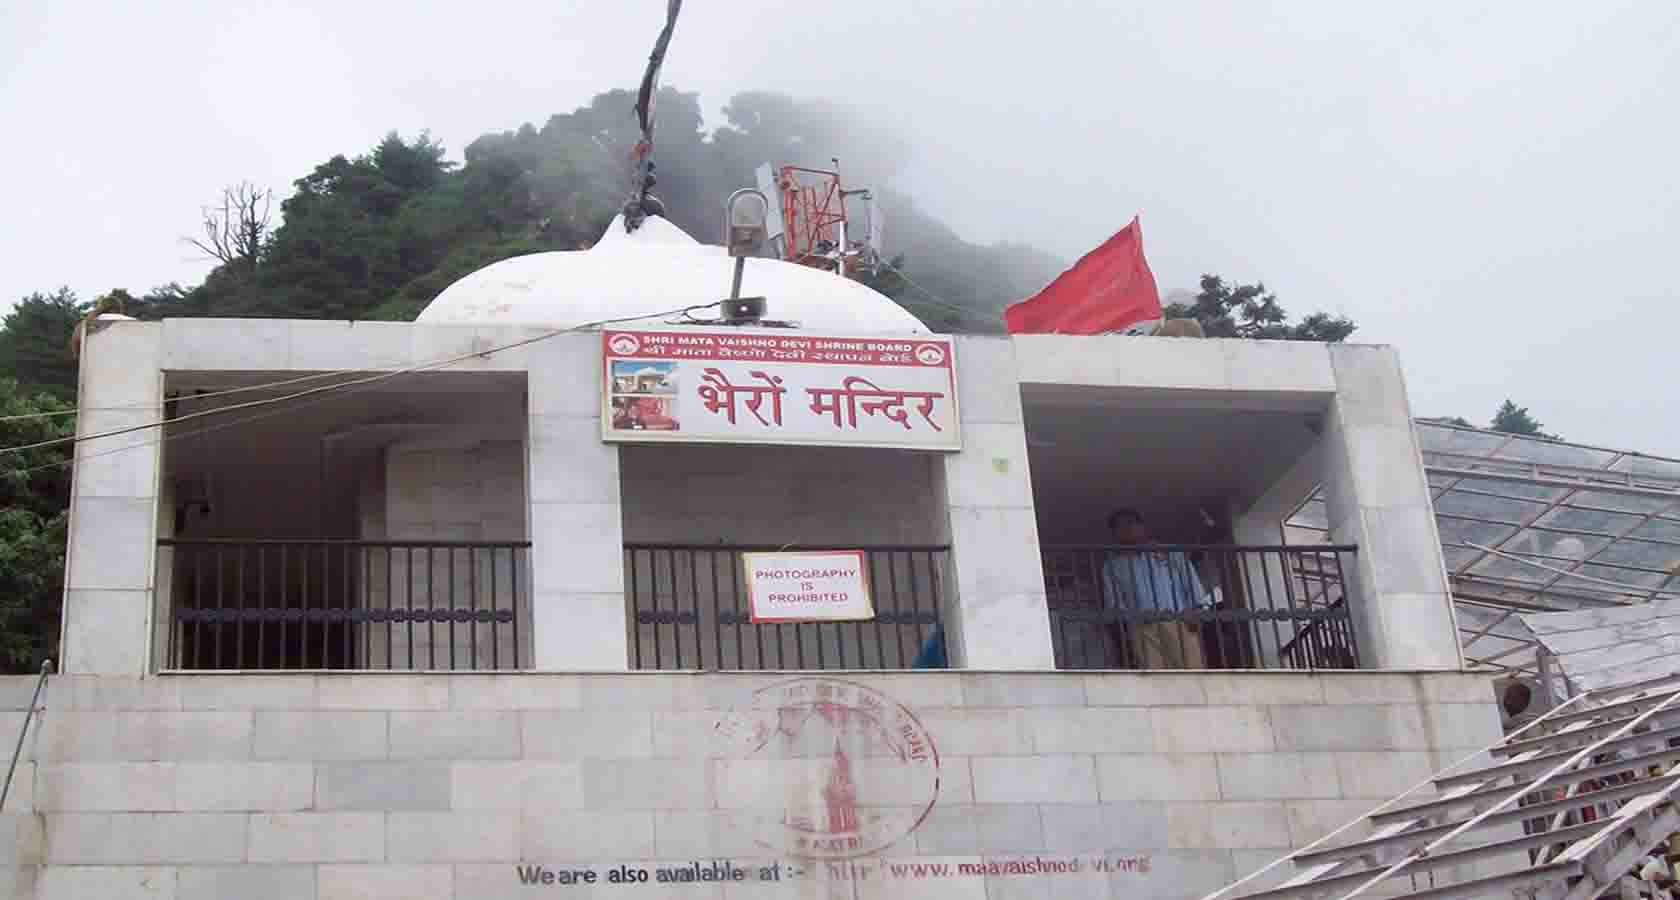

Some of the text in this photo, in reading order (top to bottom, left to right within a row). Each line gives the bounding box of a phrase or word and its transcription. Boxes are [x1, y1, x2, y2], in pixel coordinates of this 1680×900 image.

[643, 335, 912, 352] SHRI MATA VAISHNO DEVI SHRINE BOARD
[697, 367, 945, 432] भैरों मन्दिर
[755, 569, 857, 580] PHOTOGRAPHY
[800, 582, 814, 591] IS
[768, 592, 849, 603] PROHIBITED
[517, 865, 555, 885] We
[558, 869, 597, 885] are
[608, 864, 649, 883] also
[655, 860, 745, 883] available
[759, 861, 781, 881] at
